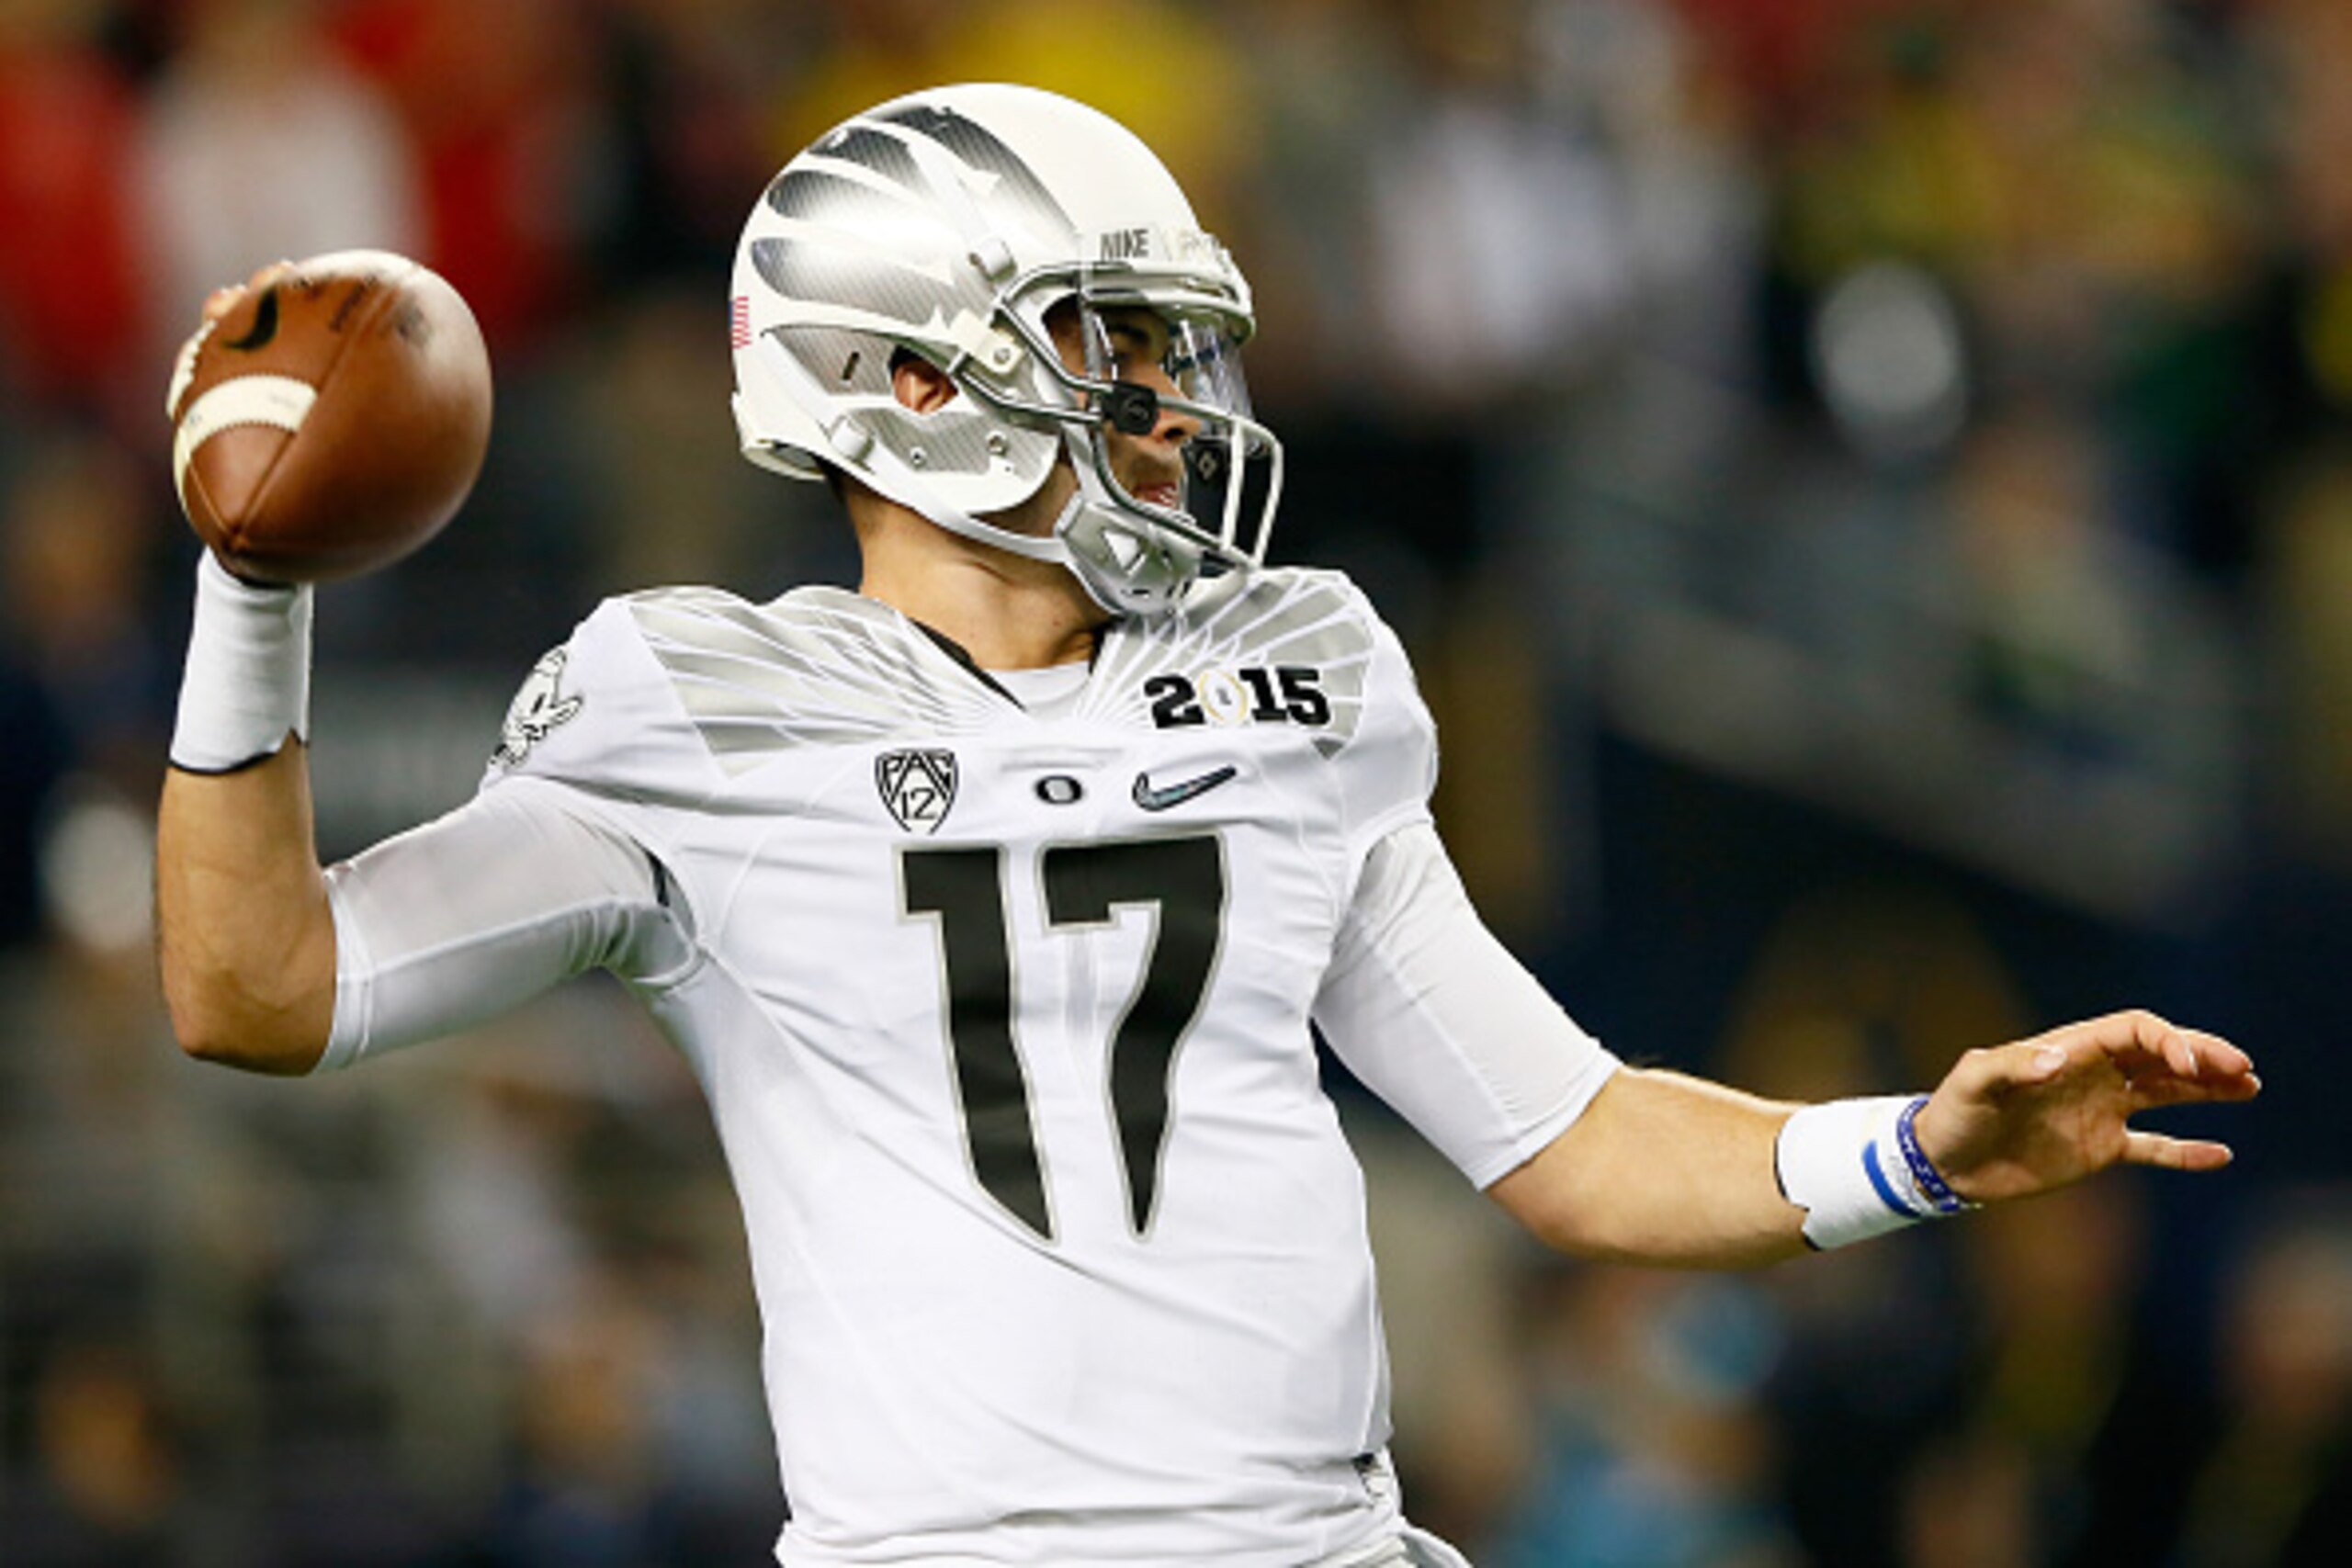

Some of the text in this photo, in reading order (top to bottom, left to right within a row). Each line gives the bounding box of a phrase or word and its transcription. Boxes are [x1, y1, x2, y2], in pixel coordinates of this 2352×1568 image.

[1100, 228, 1149, 262] NIKE
[901, 786, 936, 819] 12
[897, 833, 1228, 1244] 17
